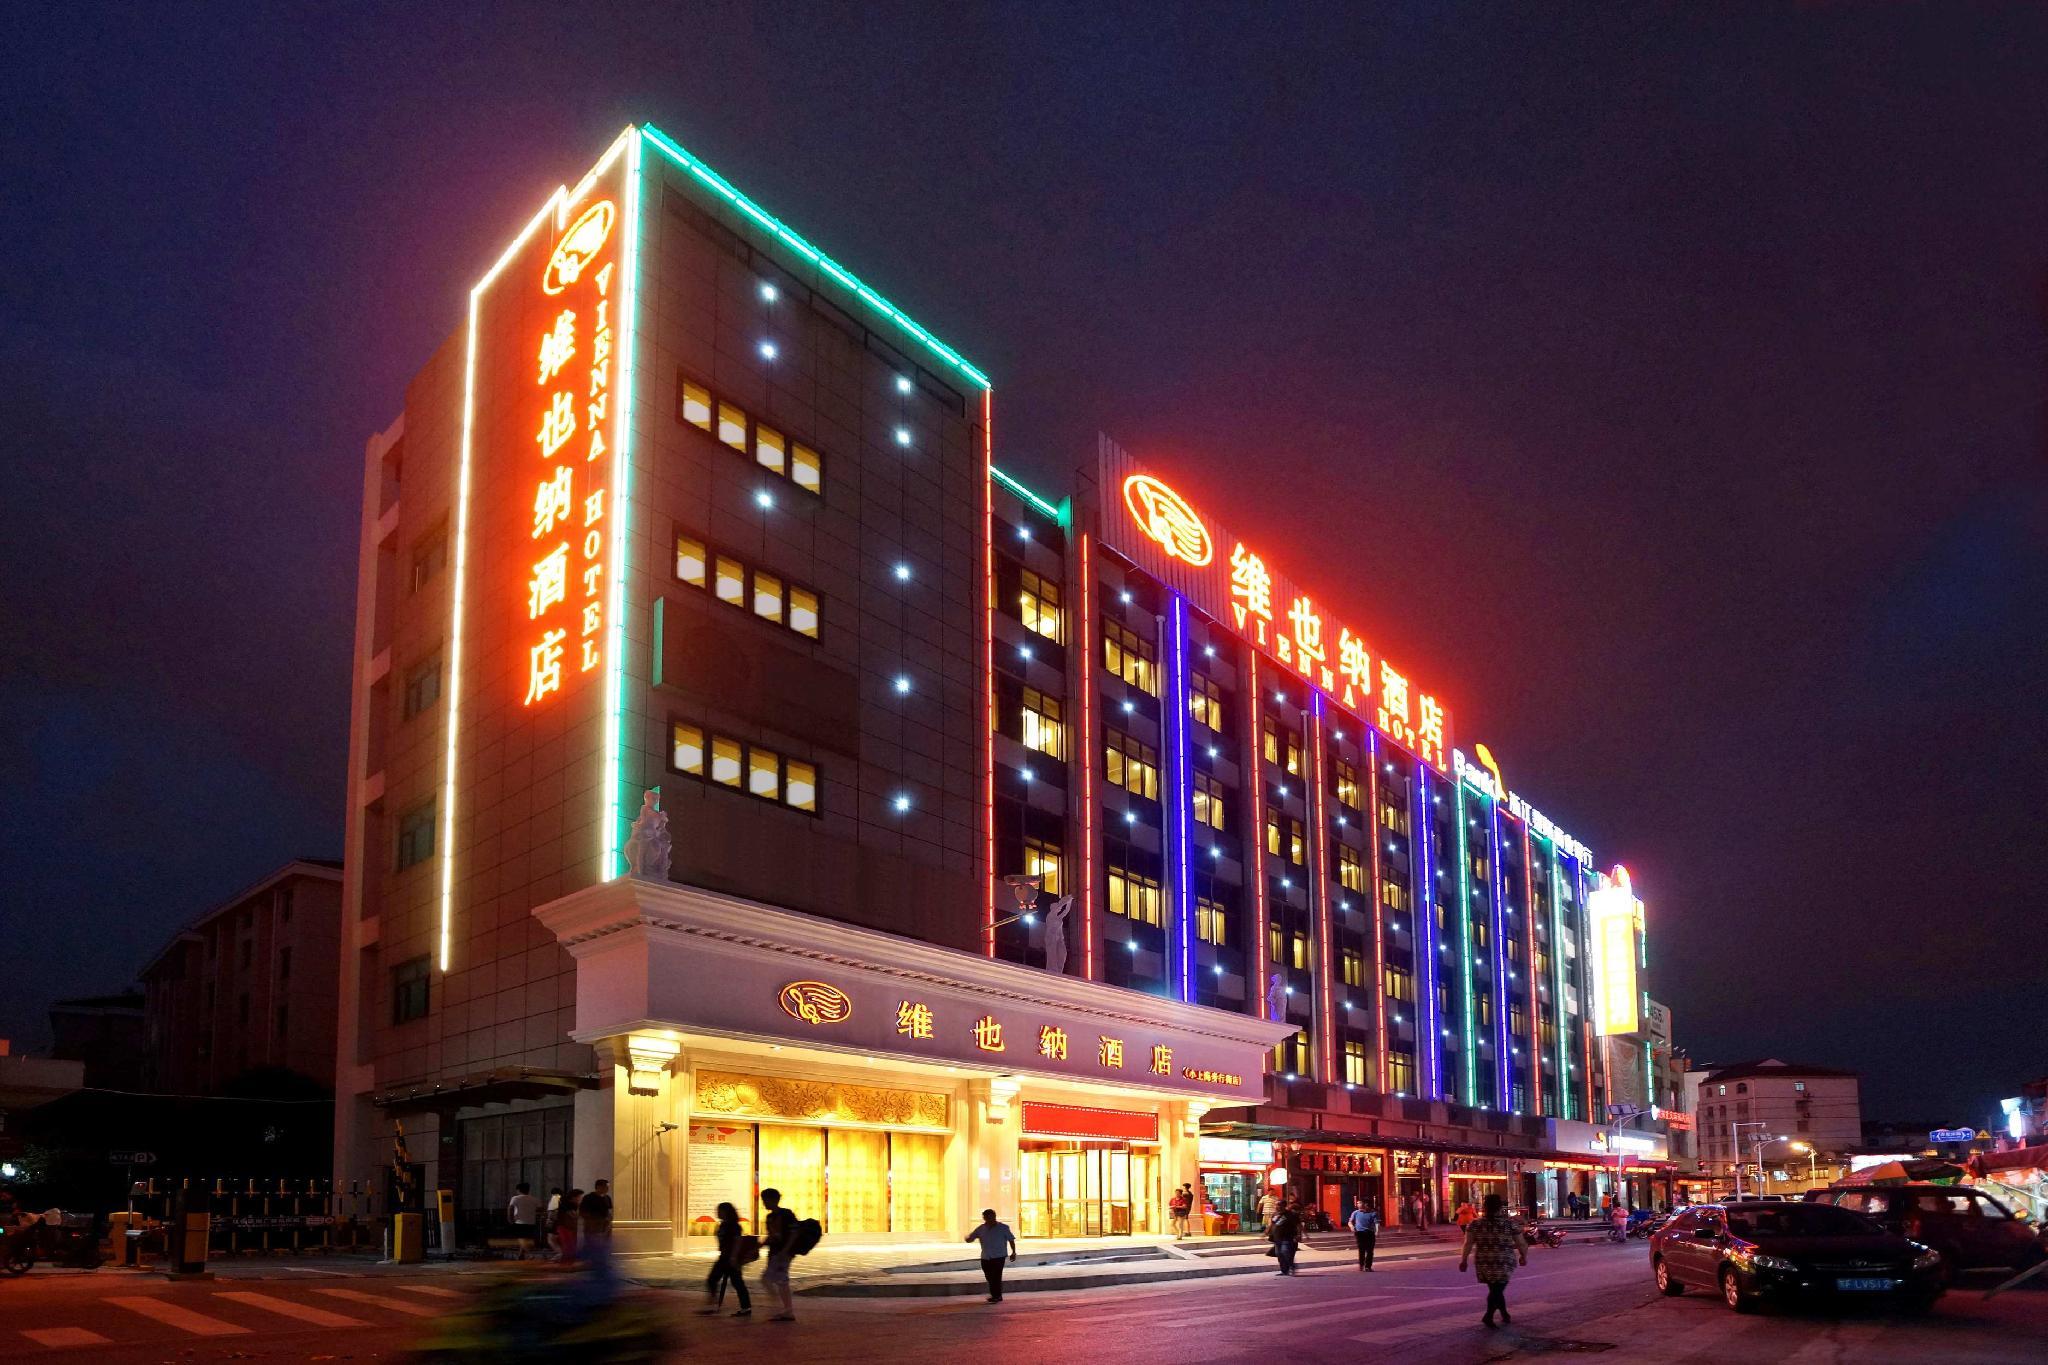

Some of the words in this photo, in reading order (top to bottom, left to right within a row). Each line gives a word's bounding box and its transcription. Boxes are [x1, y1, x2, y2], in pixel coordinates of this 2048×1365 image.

[588, 263, 615, 462] VIENNA
[524, 308, 577, 706] 维也纳酒店
[581, 488, 606, 673] HOTEL
[1230, 542, 1444, 751] 维也纳酒店
[1231, 601, 1358, 709] VIENNA
[1378, 706, 1448, 773] HOTEL
[895, 1000, 1174, 1075] 维也纳酒店
